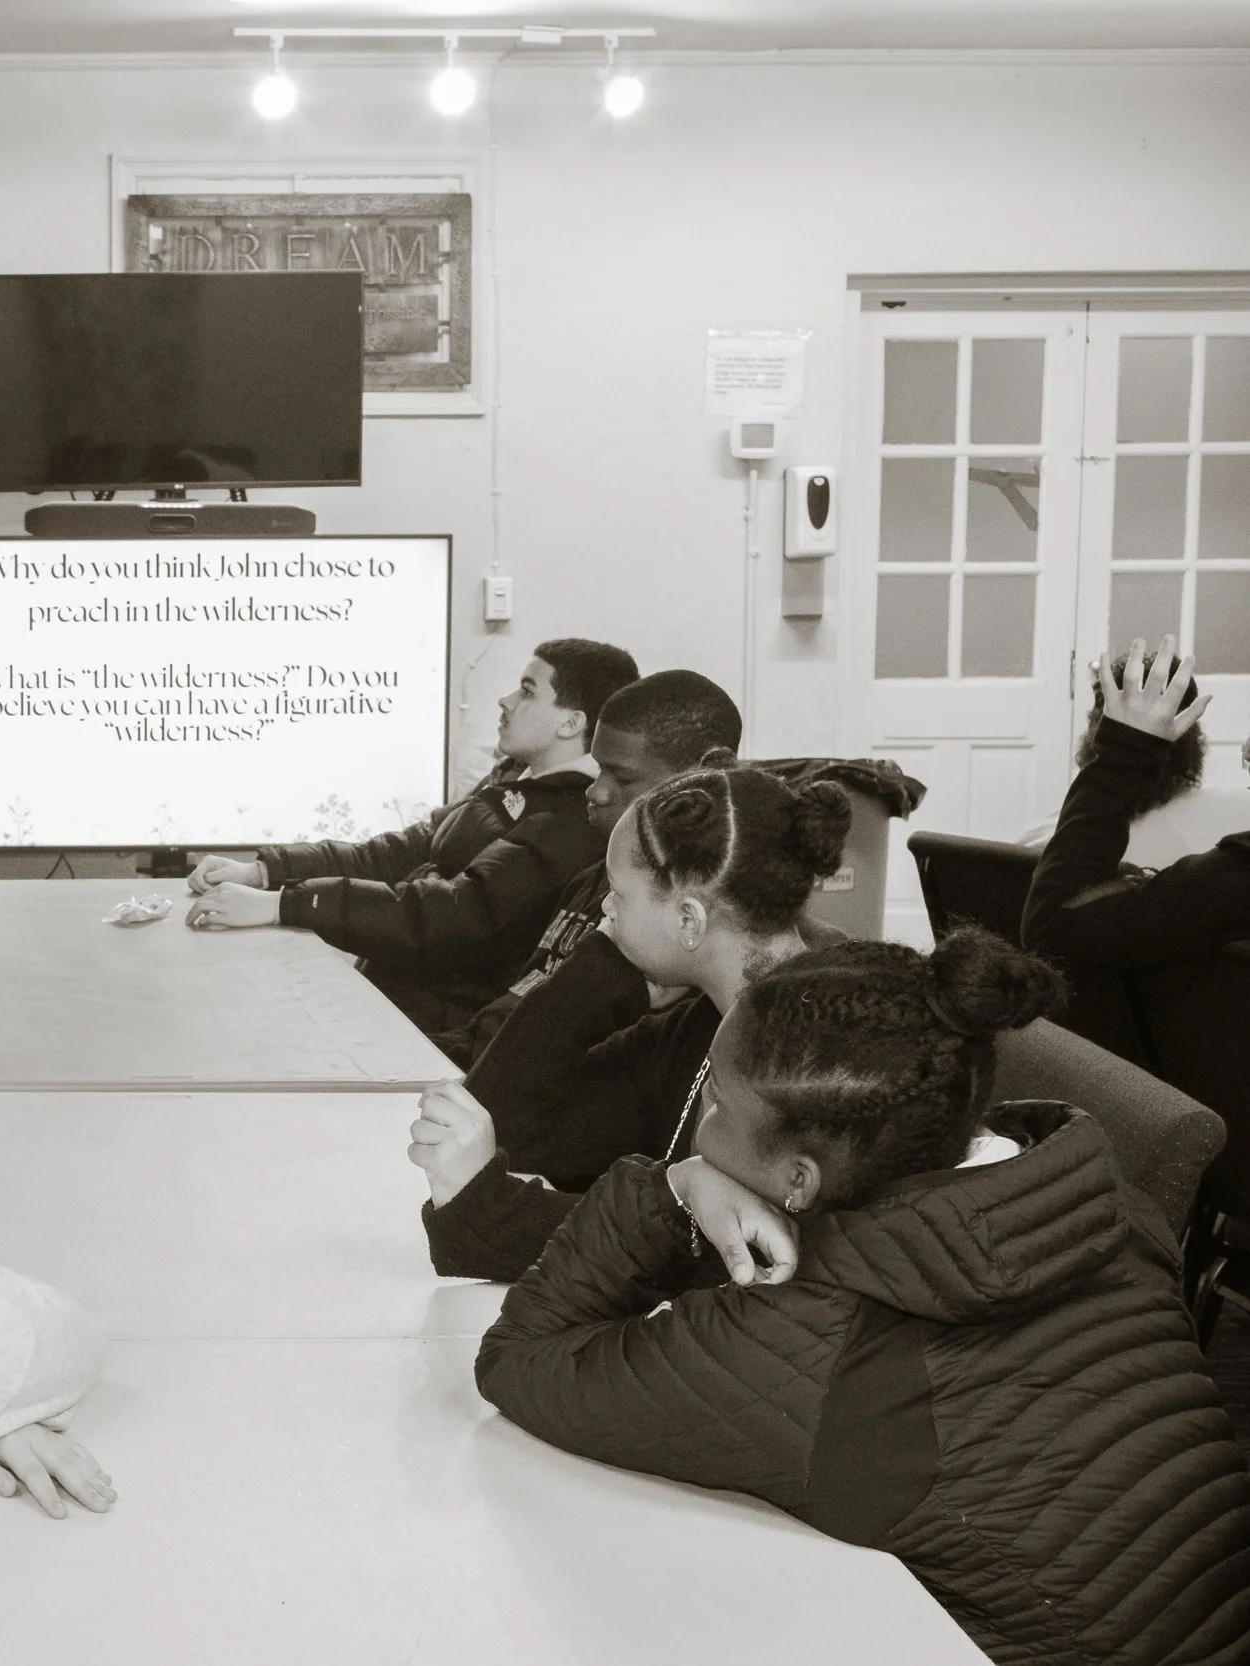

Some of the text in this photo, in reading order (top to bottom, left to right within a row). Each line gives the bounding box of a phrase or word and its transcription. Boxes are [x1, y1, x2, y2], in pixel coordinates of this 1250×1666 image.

[177, 233, 432, 277] DREAM
[50, 553, 85, 579] do
[88, 562, 139, 585] you
[145, 553, 212, 579] think
[214, 553, 278, 583] John
[284, 553, 363, 579] chose
[368, 557, 396, 578] to
[28, 597, 354, 631] preach in the wilderness?
[56, 667, 76, 689] is
[81, 664, 135, 689] “the
[140, 664, 301, 689] wilderness?”
[307, 665, 346, 688] Do
[350, 671, 399, 694] you
[78, 699, 130, 721] you
[134, 699, 182, 716] can
[187, 690, 249, 716] have
[253, 698, 269, 715] a
[274, 690, 393, 722] figurative
[103, 717, 276, 742] “wilderness?”
